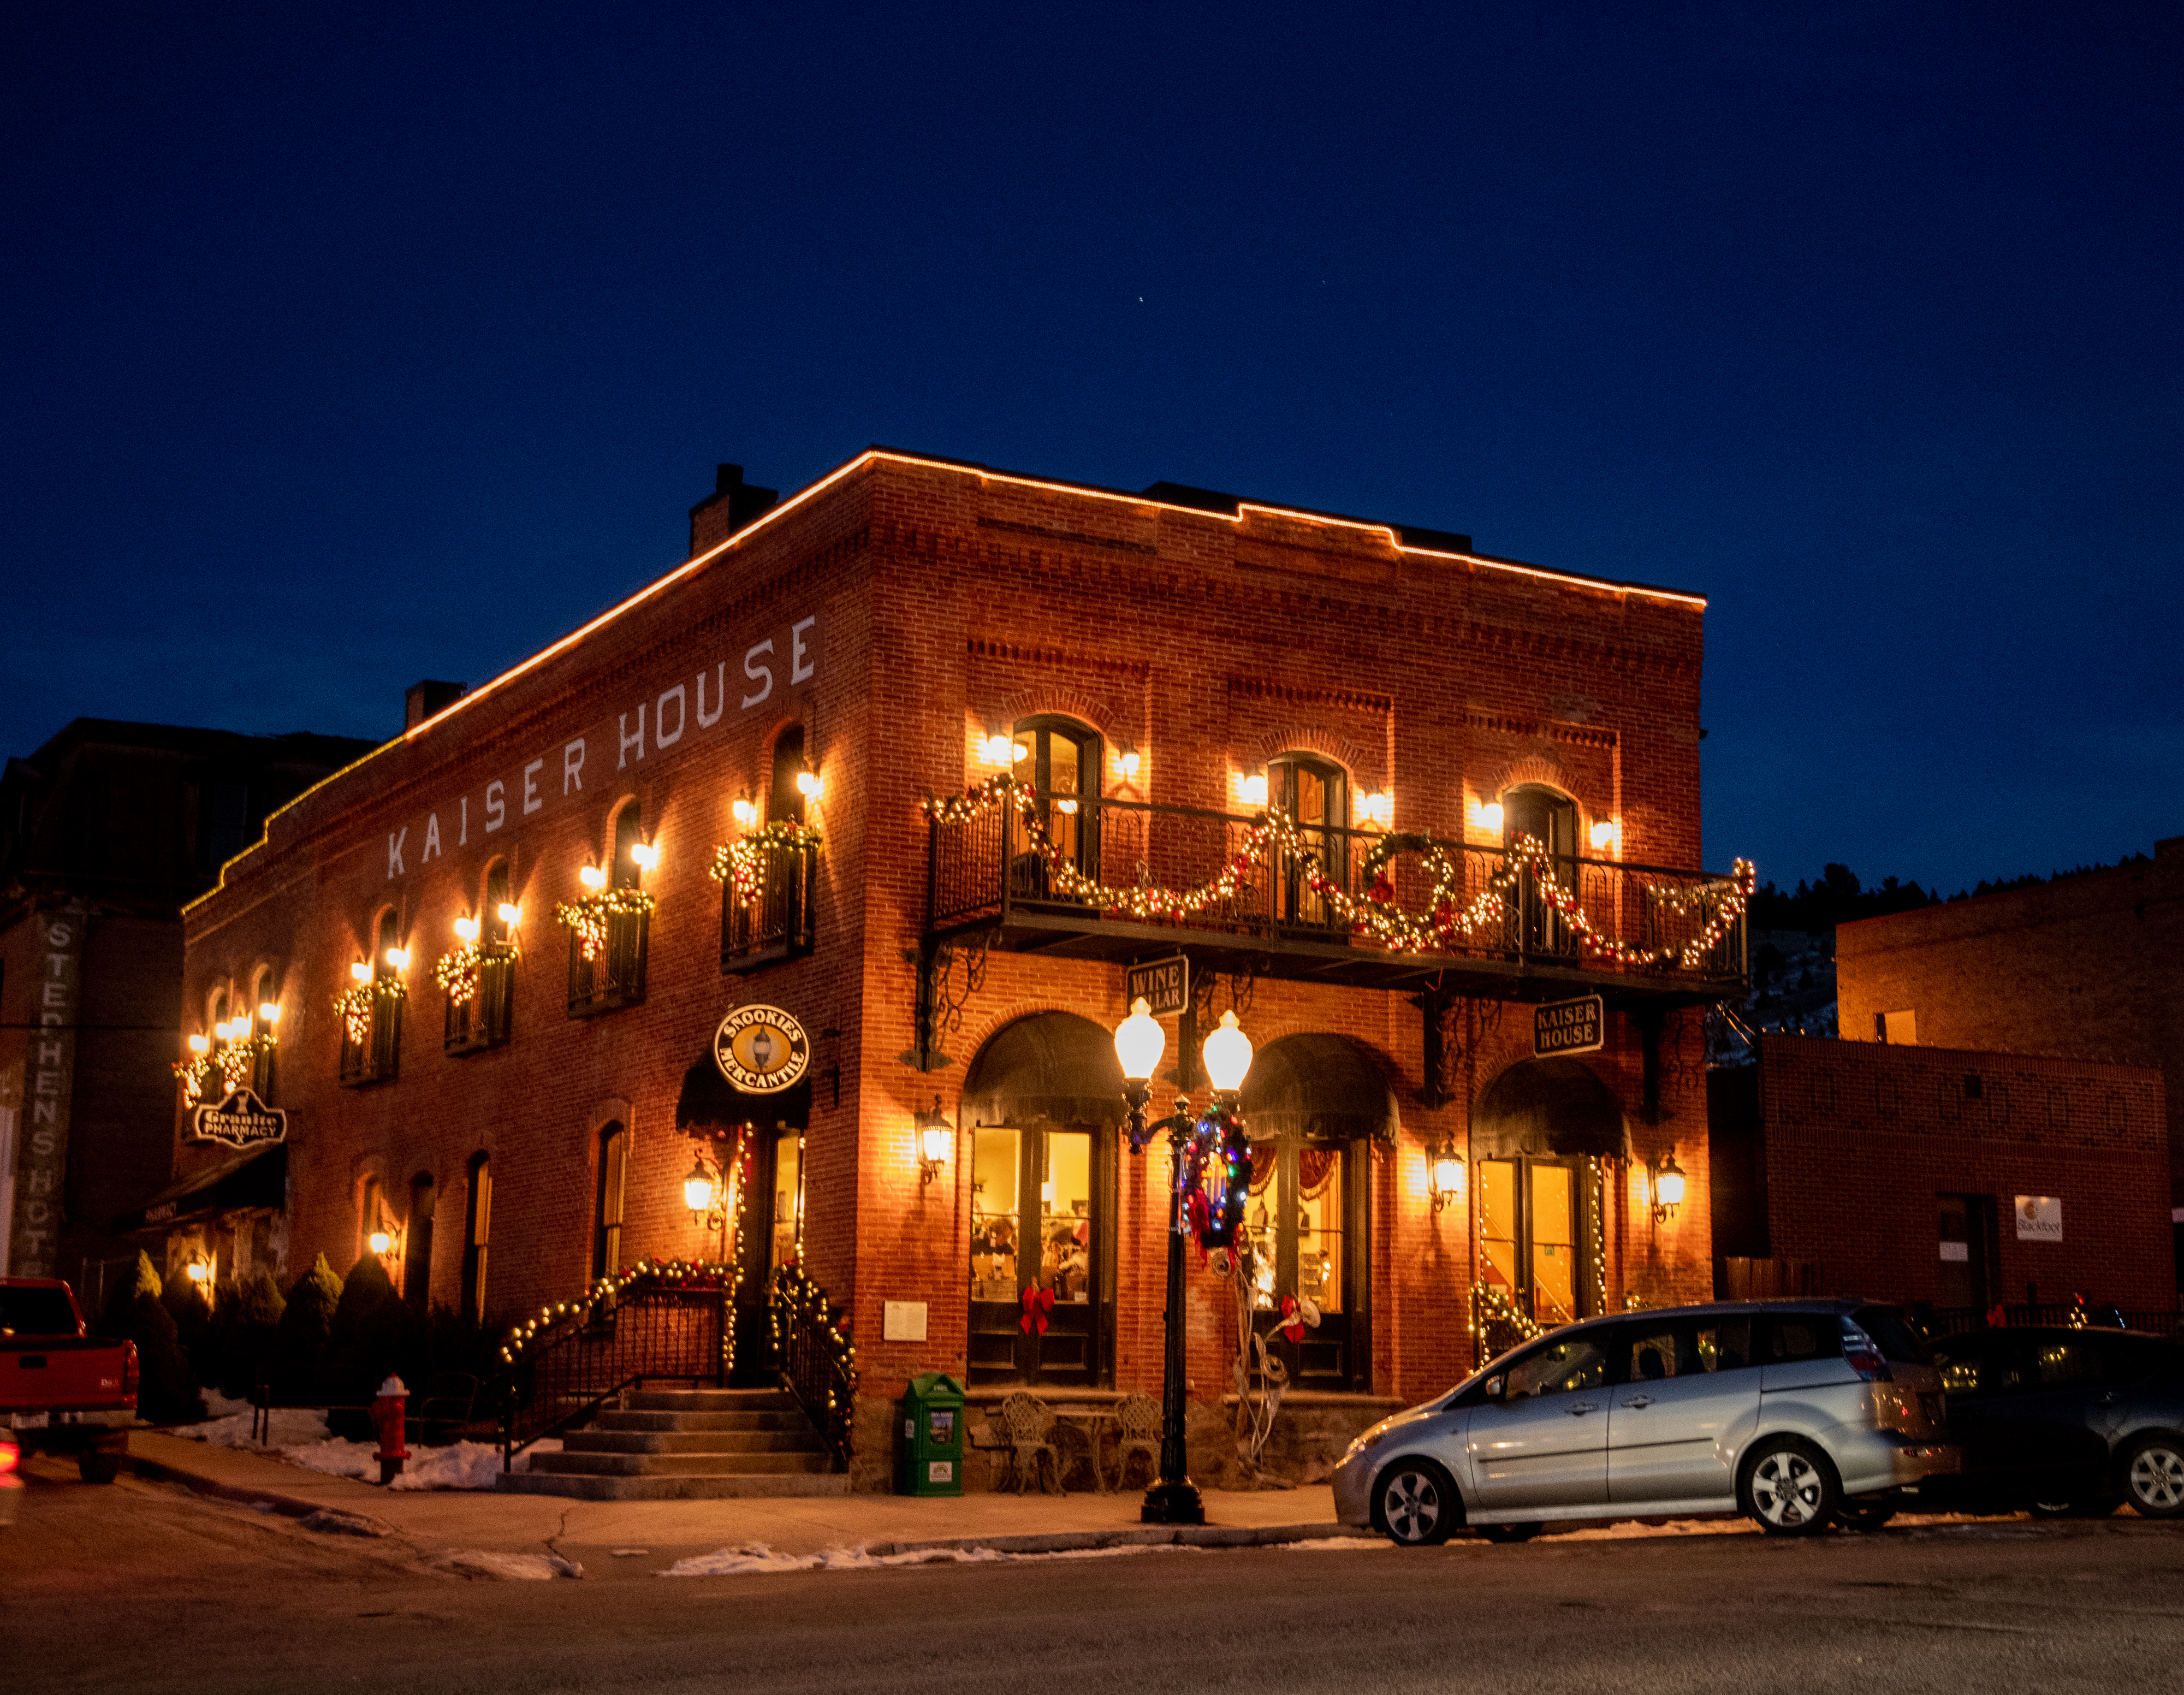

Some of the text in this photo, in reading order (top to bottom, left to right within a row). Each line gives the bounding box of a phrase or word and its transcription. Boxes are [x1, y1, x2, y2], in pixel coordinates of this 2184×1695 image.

[387, 614, 816, 880] KAISER HOUSE
[1132, 965, 1180, 995] WINE
[1142, 988, 1180, 1011] LLAR
[723, 1009, 802, 1042] SNOOKIES
[1537, 1003, 1597, 1030] KAISER
[1540, 1023, 1594, 1049] HOUSE
[720, 1047, 805, 1087] MERCANTILE
[205, 1122, 277, 1137] PHARMACY
